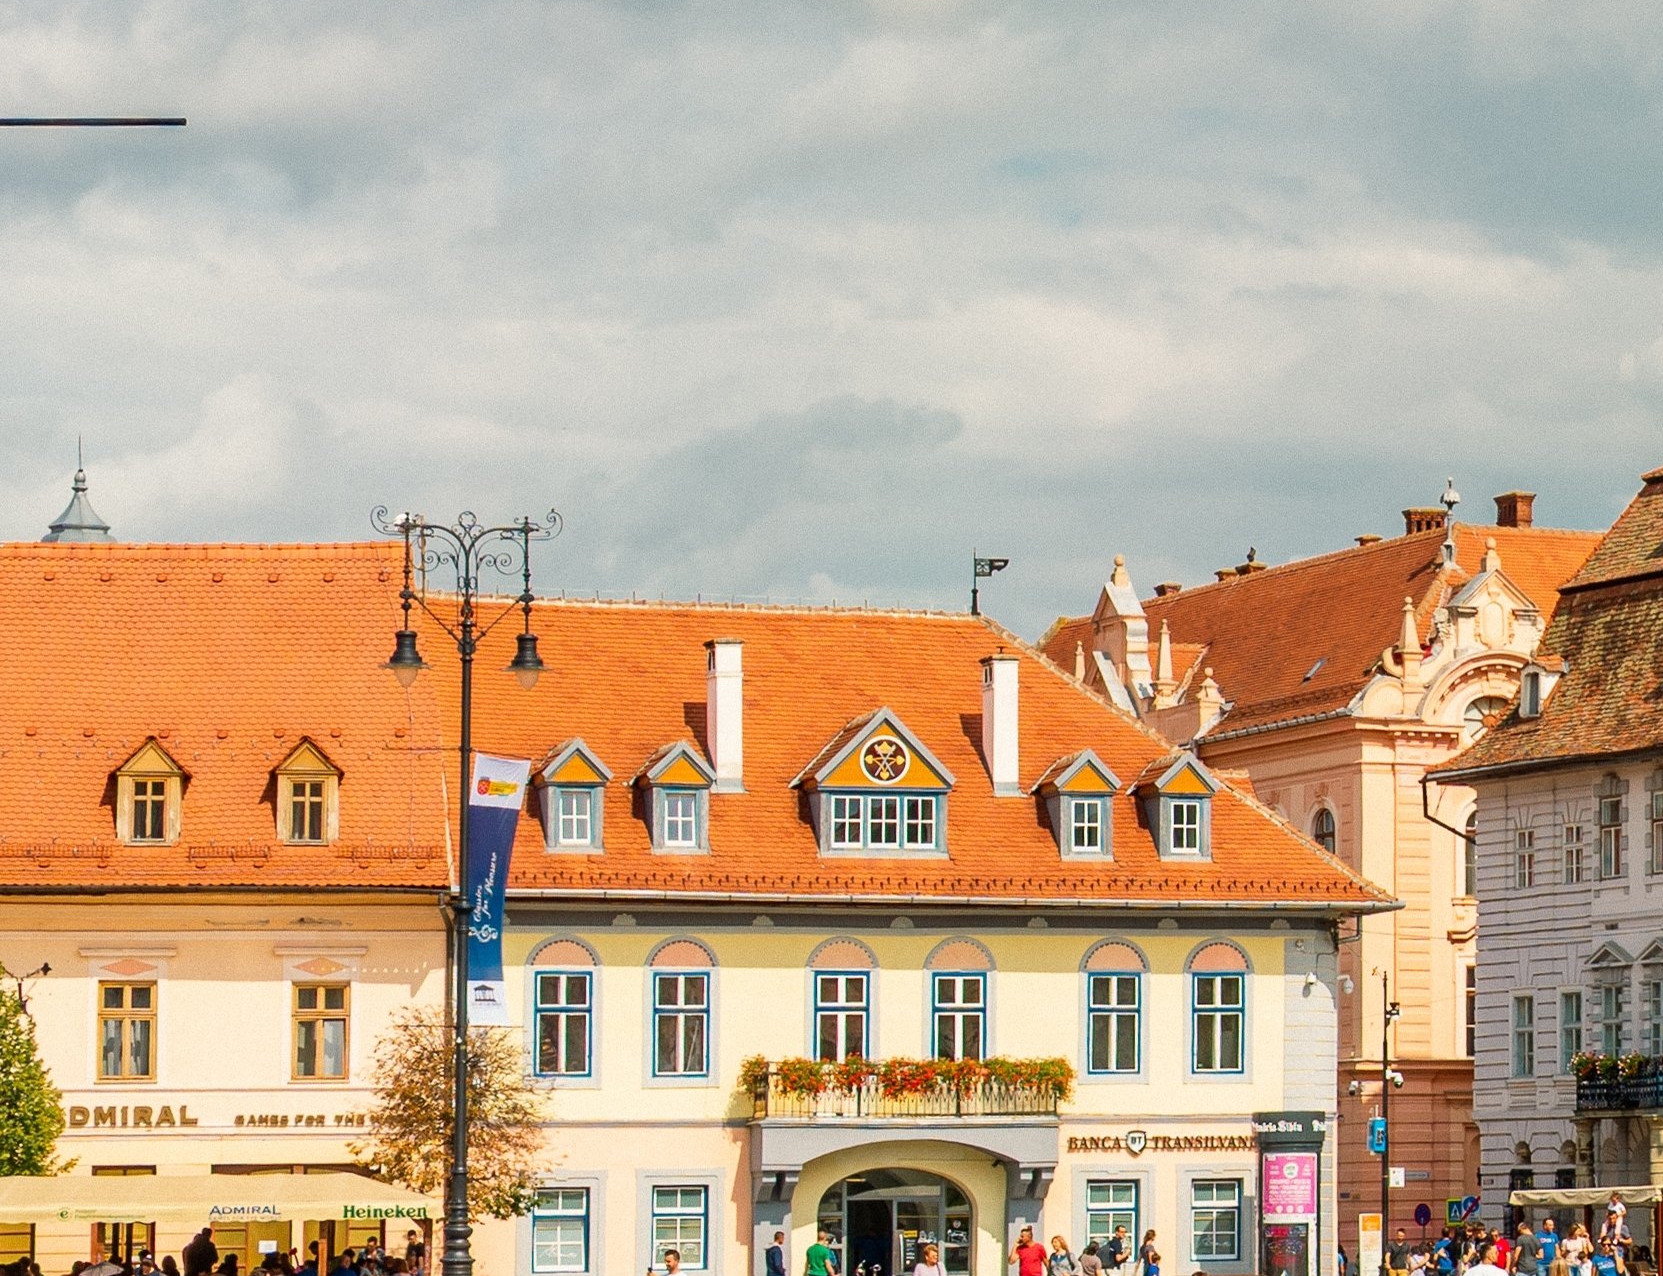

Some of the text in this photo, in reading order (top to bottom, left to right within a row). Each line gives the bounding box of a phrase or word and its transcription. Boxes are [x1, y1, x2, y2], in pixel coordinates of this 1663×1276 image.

[69, 1105, 198, 1127] DMIRAL
[234, 1115, 289, 1127] GAMES
[295, 1115, 325, 1127] FOR
[334, 1114, 365, 1127] THE
[1068, 1136, 1121, 1150] BANCA
[1130, 1136, 1142, 1144] BT
[209, 1205, 282, 1215] ADMIRAL
[342, 1205, 429, 1219] Heineken
